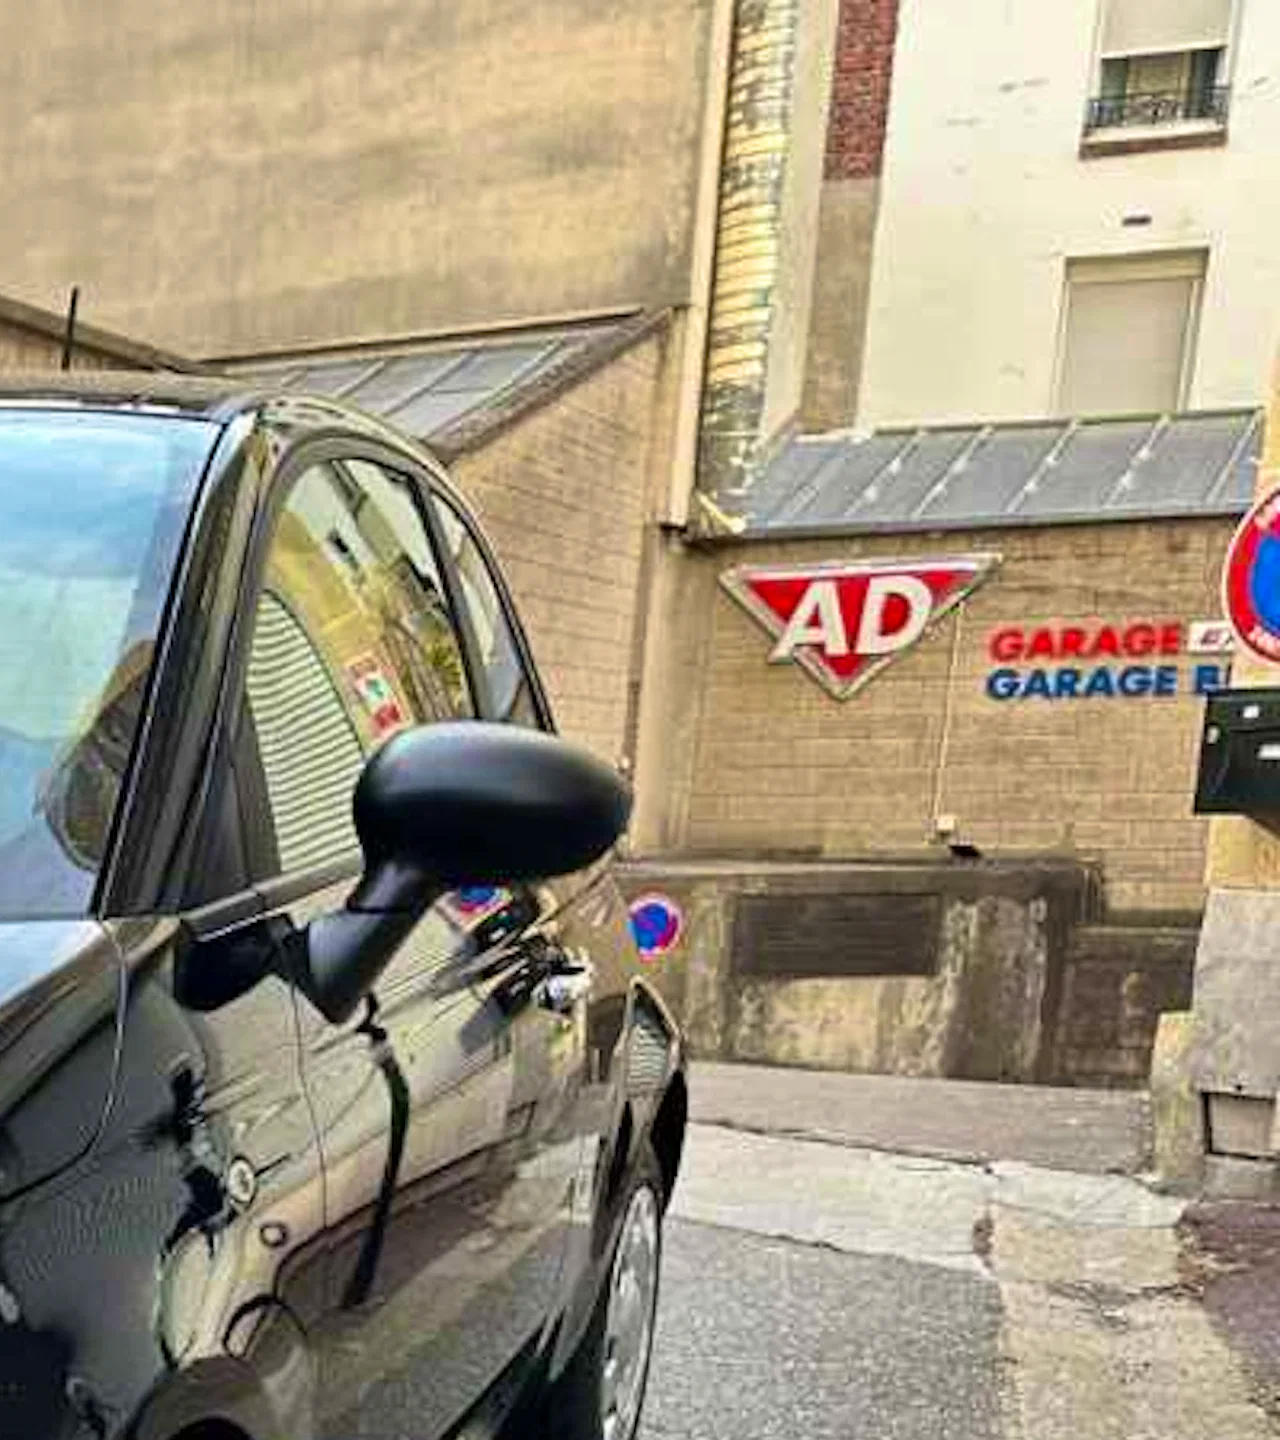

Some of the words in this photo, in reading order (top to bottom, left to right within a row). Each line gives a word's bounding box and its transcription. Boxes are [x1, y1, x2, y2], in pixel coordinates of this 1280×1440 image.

[767, 574, 933, 665] AD
[988, 622, 1181, 663] GARAGE
[986, 665, 1178, 700] GARAGE
